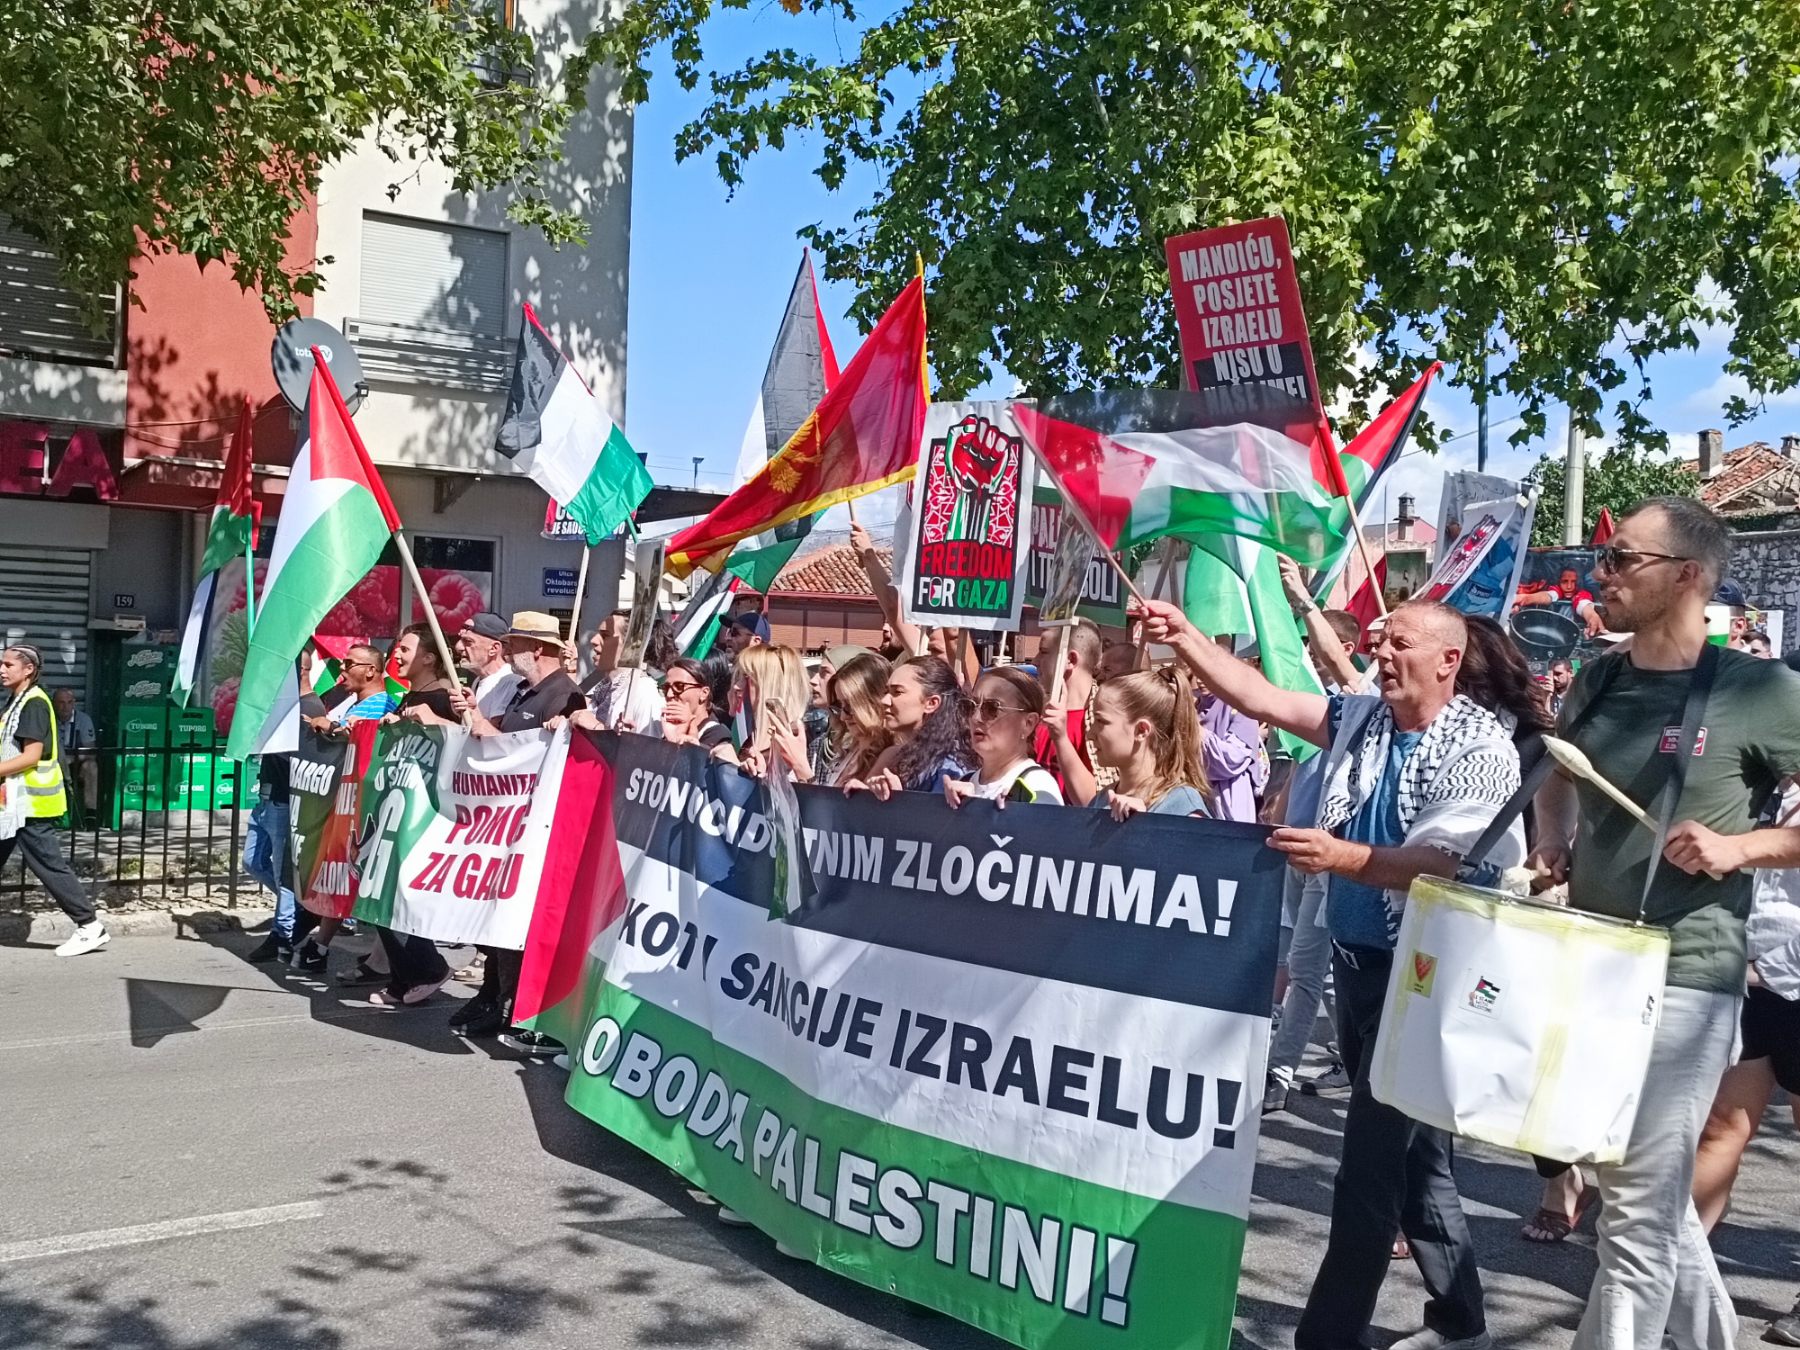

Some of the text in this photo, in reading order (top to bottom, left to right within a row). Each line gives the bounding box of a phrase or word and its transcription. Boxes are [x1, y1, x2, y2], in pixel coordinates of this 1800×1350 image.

[1179, 233, 1282, 282] MANDIĆU,
[1193, 272, 1280, 314] POSJETE
[1202, 308, 1283, 348] IZRAELU
[1213, 344, 1283, 381] NISU U
[921, 541, 1013, 579] FREEDOM
[545, 577, 578, 586] Oktobars
[547, 587, 578, 595] revoluci
[918, 577, 1008, 610] FOR GAZA
[115, 596, 133, 607] 159
[289, 757, 335, 796] BARGO
[453, 771, 538, 796] HUMANITA
[408, 852, 458, 893] ZA
[891, 834, 1239, 937] ZLOČINIMA!
[889, 1008, 1243, 1149] IZRAELU!
[583, 1017, 1137, 1327] OBODA PALESTINI!
